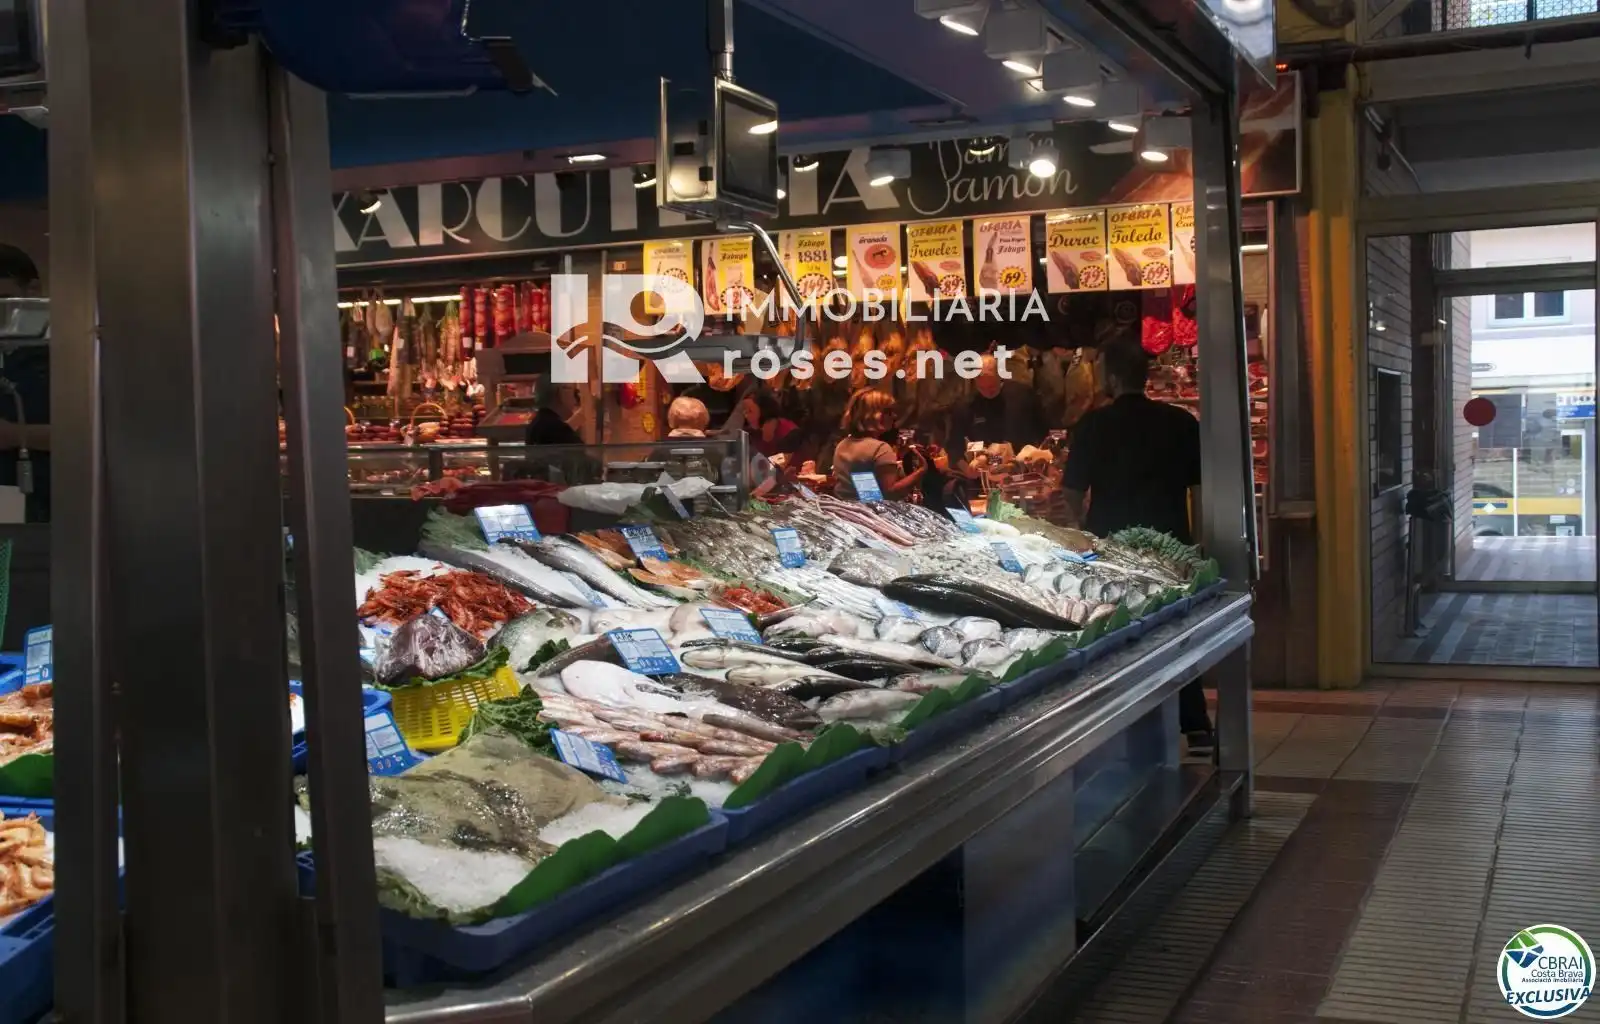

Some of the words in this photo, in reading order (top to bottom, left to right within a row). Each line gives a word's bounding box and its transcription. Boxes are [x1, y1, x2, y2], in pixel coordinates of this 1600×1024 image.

[1049, 233, 1101, 247] Duroc
[1110, 228, 1162, 244] Toledo
[797, 250, 828, 263] 1881
[910, 242, 960, 258] Trevelez
[996, 245, 1026, 254] Jabugo
